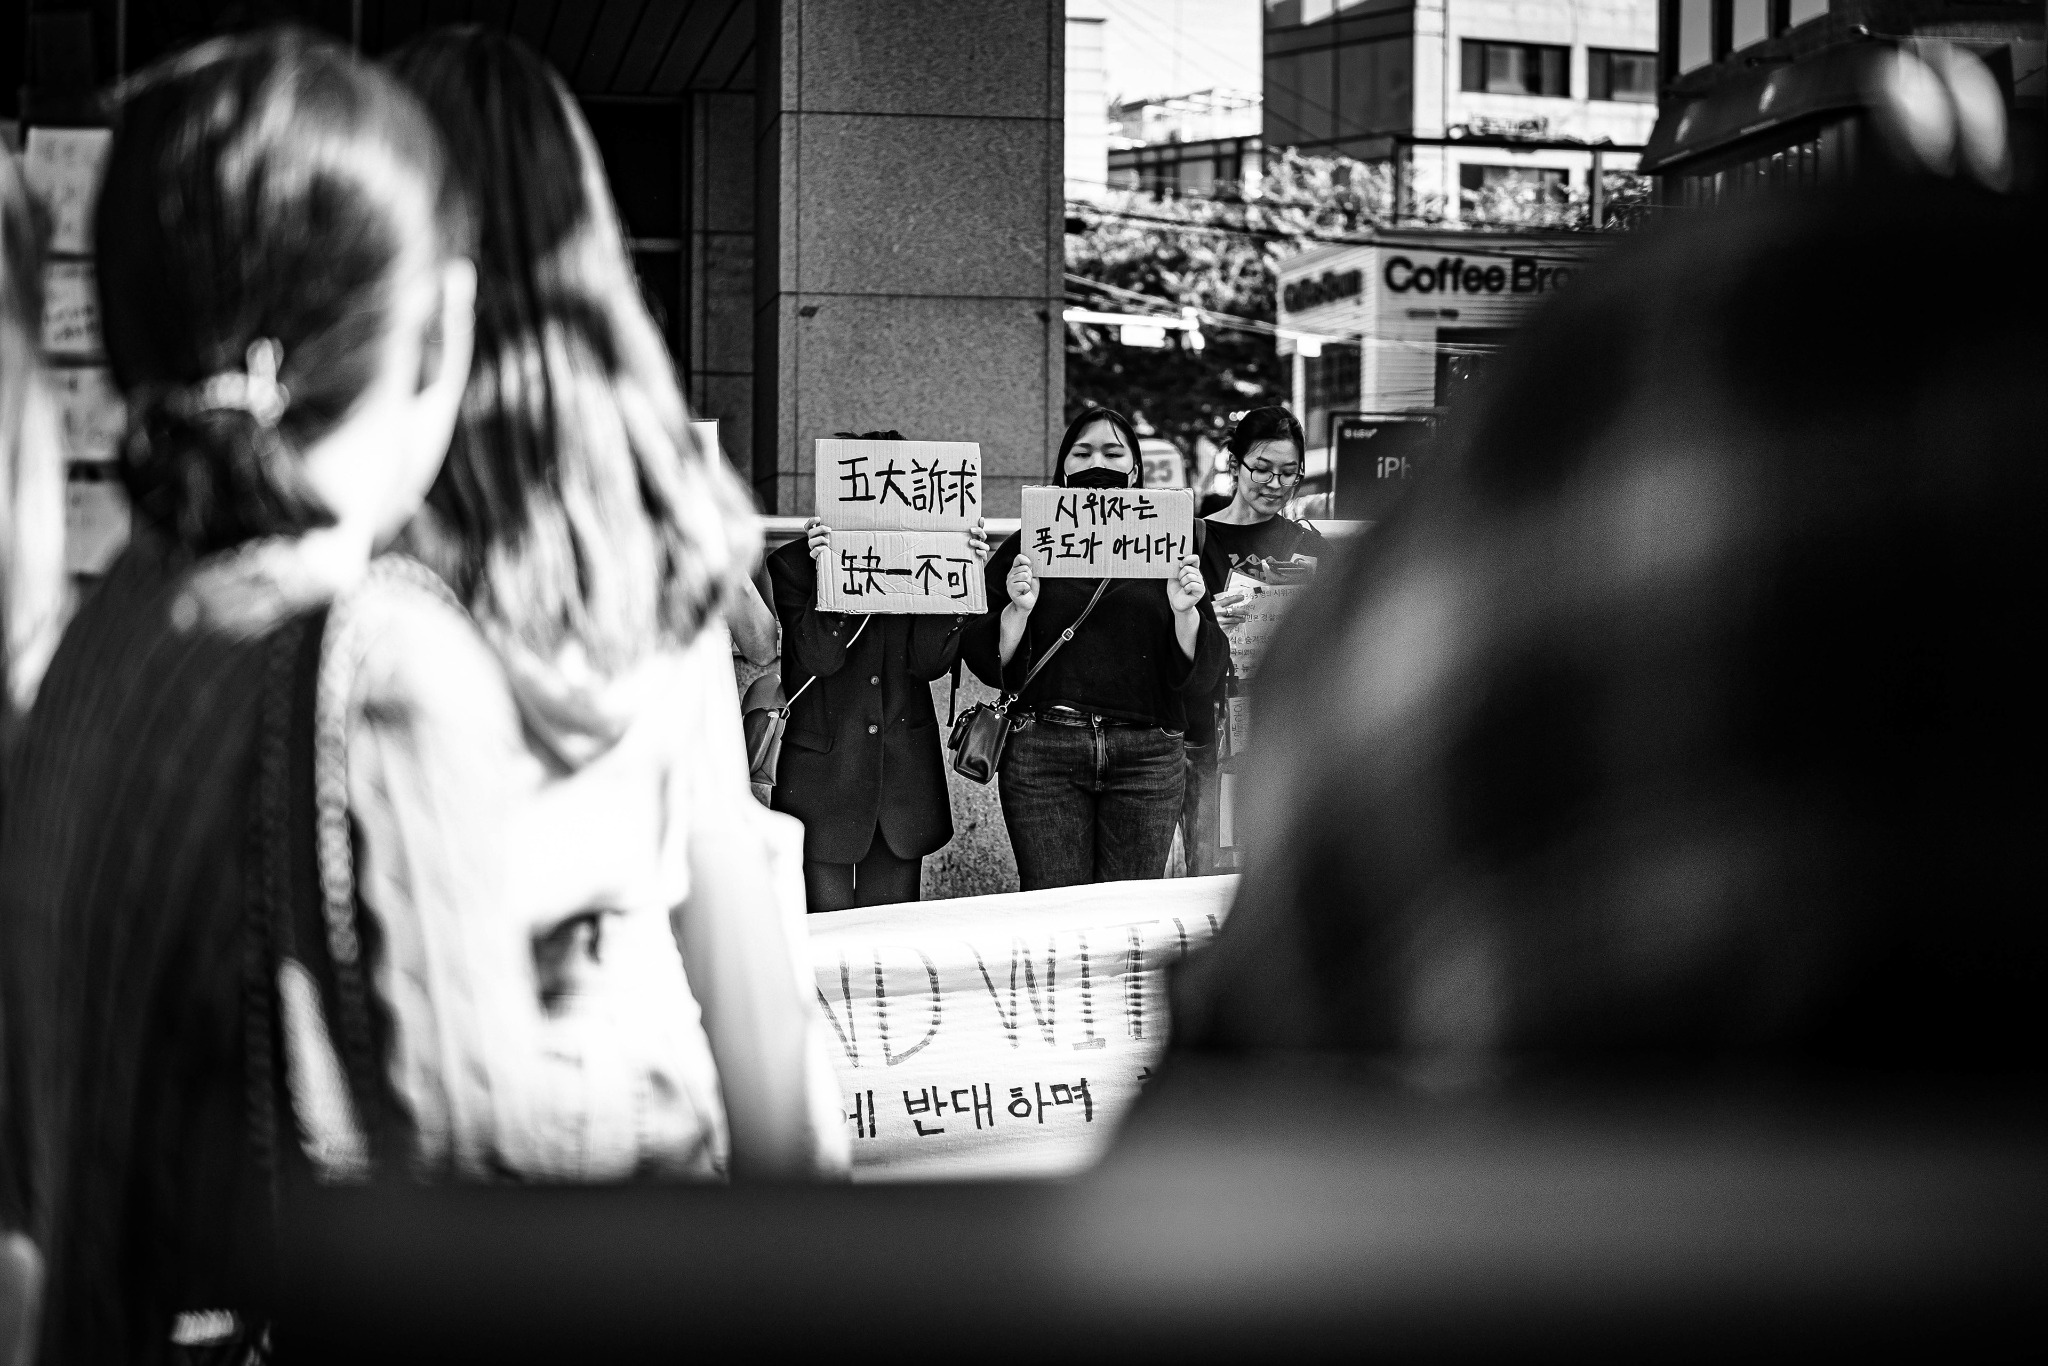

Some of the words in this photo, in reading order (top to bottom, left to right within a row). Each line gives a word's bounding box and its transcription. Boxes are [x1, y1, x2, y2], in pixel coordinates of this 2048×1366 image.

[1384, 256, 1505, 293] Coffee
[838, 457, 977, 517] 五大訴求
[1055, 493, 1158, 528] 시위자는
[1032, 527, 1102, 565] 폭도가
[1112, 532, 1186, 563] 아니다!
[842, 546, 973, 599] 缺一不可
